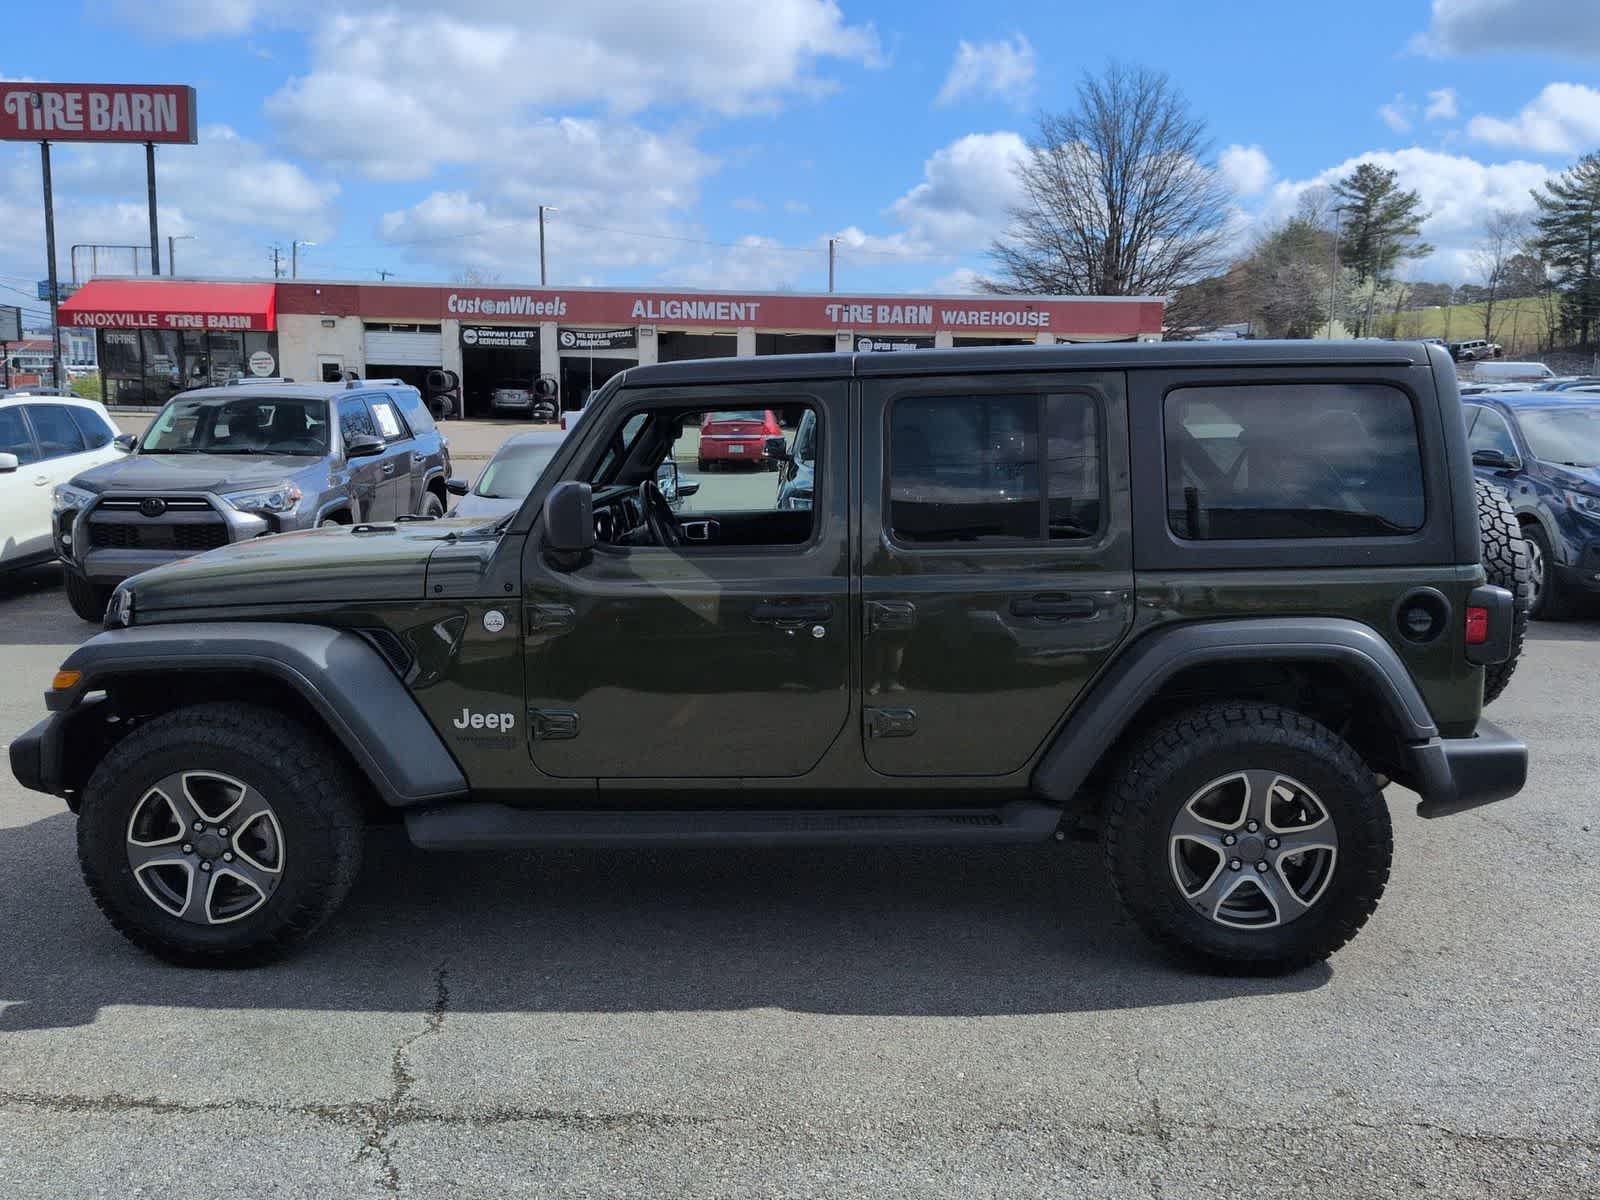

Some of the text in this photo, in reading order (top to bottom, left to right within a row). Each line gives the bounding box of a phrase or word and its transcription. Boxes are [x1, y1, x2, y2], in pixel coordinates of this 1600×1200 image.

[88, 92, 178, 132] BARN
[73, 312, 158, 327] KNOXVILLE
[207, 315, 252, 329] BARN
[631, 300, 760, 321] ALIGNMENT
[876, 304, 933, 325] BARN
[941, 310, 1050, 327] WAREHOUSE
[478, 330, 509, 338] COMPANY
[453, 708, 514, 733] Jeep
